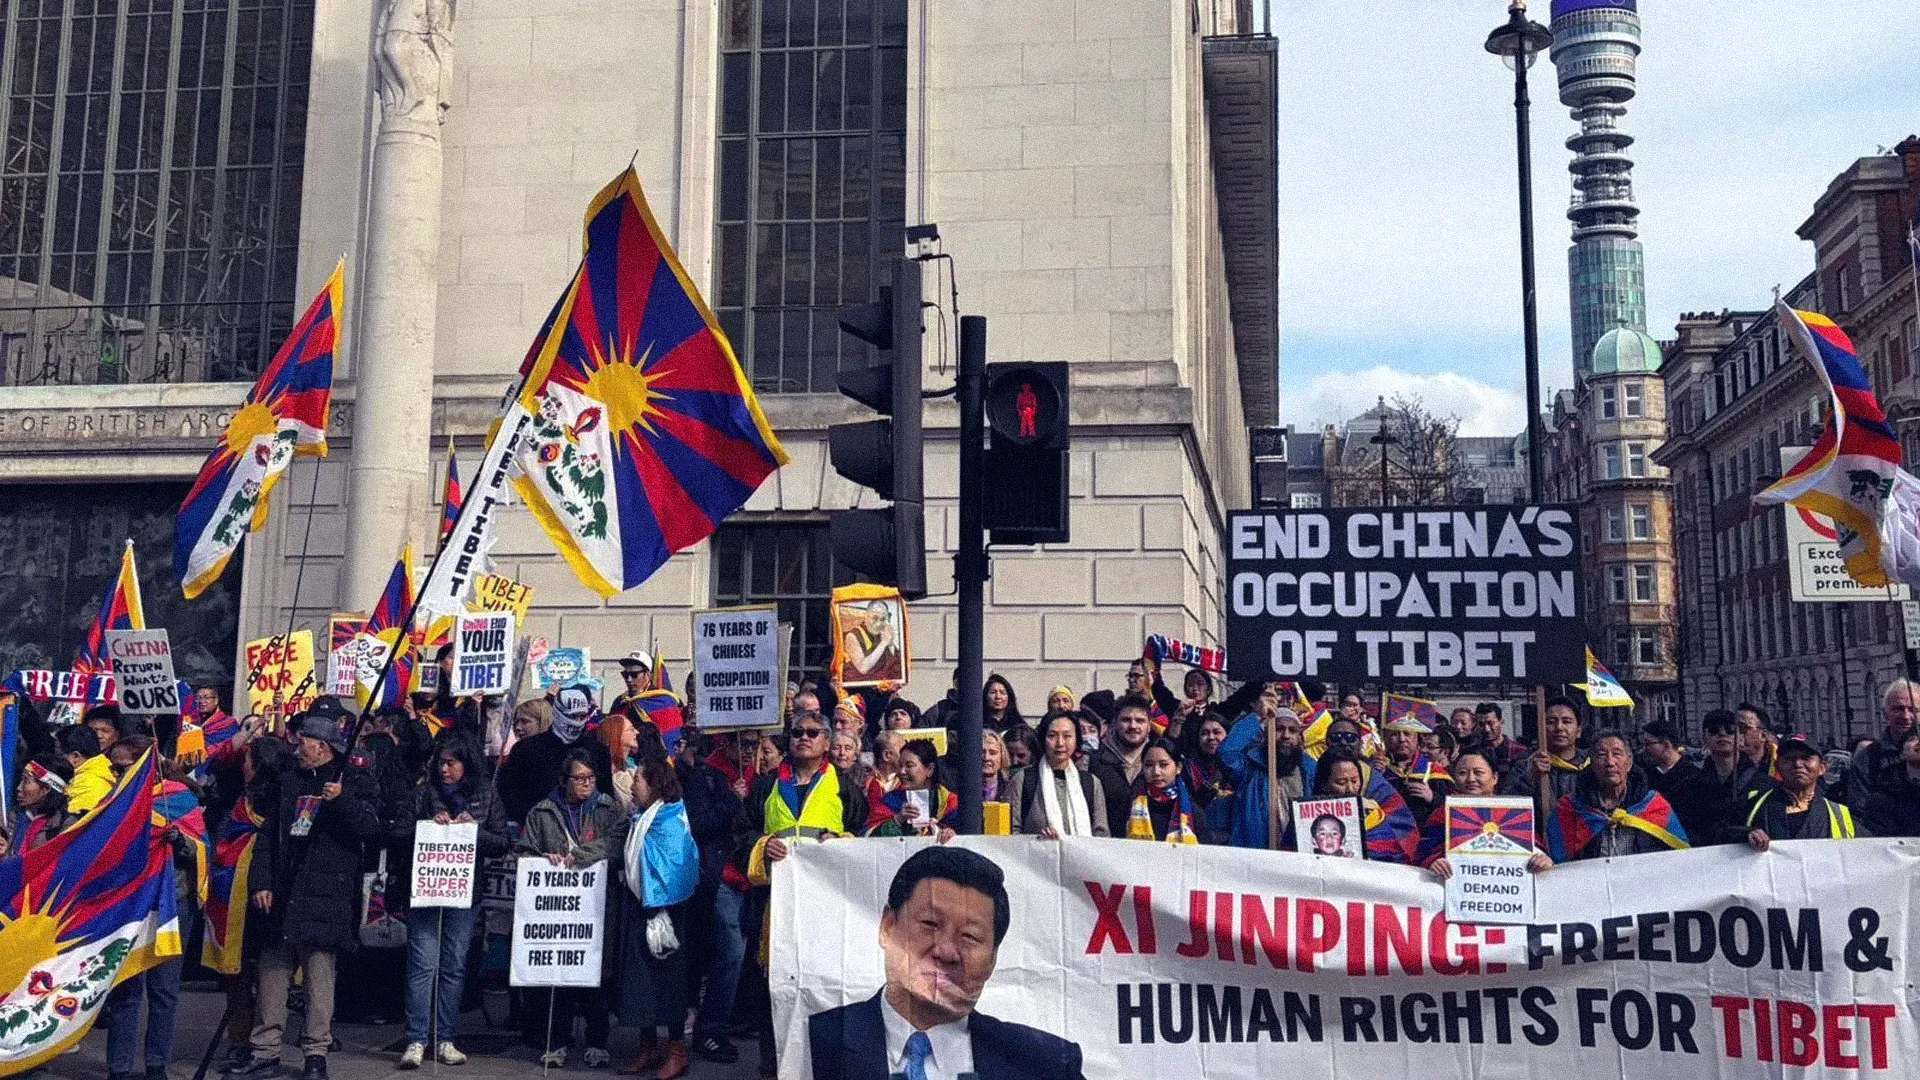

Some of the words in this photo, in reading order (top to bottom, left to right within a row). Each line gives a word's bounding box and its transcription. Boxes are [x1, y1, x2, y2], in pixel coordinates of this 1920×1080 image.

[21, 415, 50, 432] OF
[67, 414, 166, 432] BRITISH
[1232, 513, 1330, 560] END
[1346, 506, 1574, 560] CHINA'S
[450, 496, 495, 598] TIBET
[1807, 547, 1843, 560] Exce
[1813, 564, 1848, 575] acce
[482, 574, 533, 603] TIBET
[1232, 570, 1576, 618] OCCUPATION
[702, 622, 716, 638] 76
[719, 621, 753, 637] YEARS
[755, 620, 769, 637] OF
[111, 638, 171, 657] CHINA
[462, 630, 505, 653] YOUR
[712, 643, 757, 659] CHINESE
[1270, 630, 1338, 676] OF
[1356, 630, 1536, 678] TIBET
[112, 659, 163, 675] RETURN
[20, 670, 86, 699] FREE
[256, 669, 294, 692] OUR
[459, 663, 505, 690] TIBET
[703, 670, 770, 687] OCCUPATION
[123, 685, 177, 709] OURS
[710, 696, 734, 712] FREE
[736, 695, 765, 712] TIBET
[1300, 801, 1352, 819] MISSING
[418, 842, 475, 853] TIBETANS
[417, 852, 474, 864] OPPOSE
[418, 866, 470, 878] CHINA'S
[527, 871, 541, 887] 76
[545, 871, 579, 887] YEARS
[582, 870, 596, 887] OF
[1459, 864, 1524, 878] TIBETANS
[417, 877, 468, 889] SUPER
[1463, 882, 1519, 896] DEMAND
[534, 895, 581, 912] CHINESE
[1459, 901, 1523, 914] FREEDOM
[523, 923, 594, 940] OCCUPATION
[1083, 881, 1158, 955] XI
[1527, 906, 1824, 972] FREEDOM
[1843, 906, 1893, 973] &
[528, 950, 554, 967] FREE
[556, 949, 587, 967] TIBET
[1117, 983, 1324, 1044] HUMAN
[1340, 986, 1560, 1047] RIGHTS
[1577, 987, 1700, 1054] FOR
[1711, 995, 1897, 1070] TIBET
